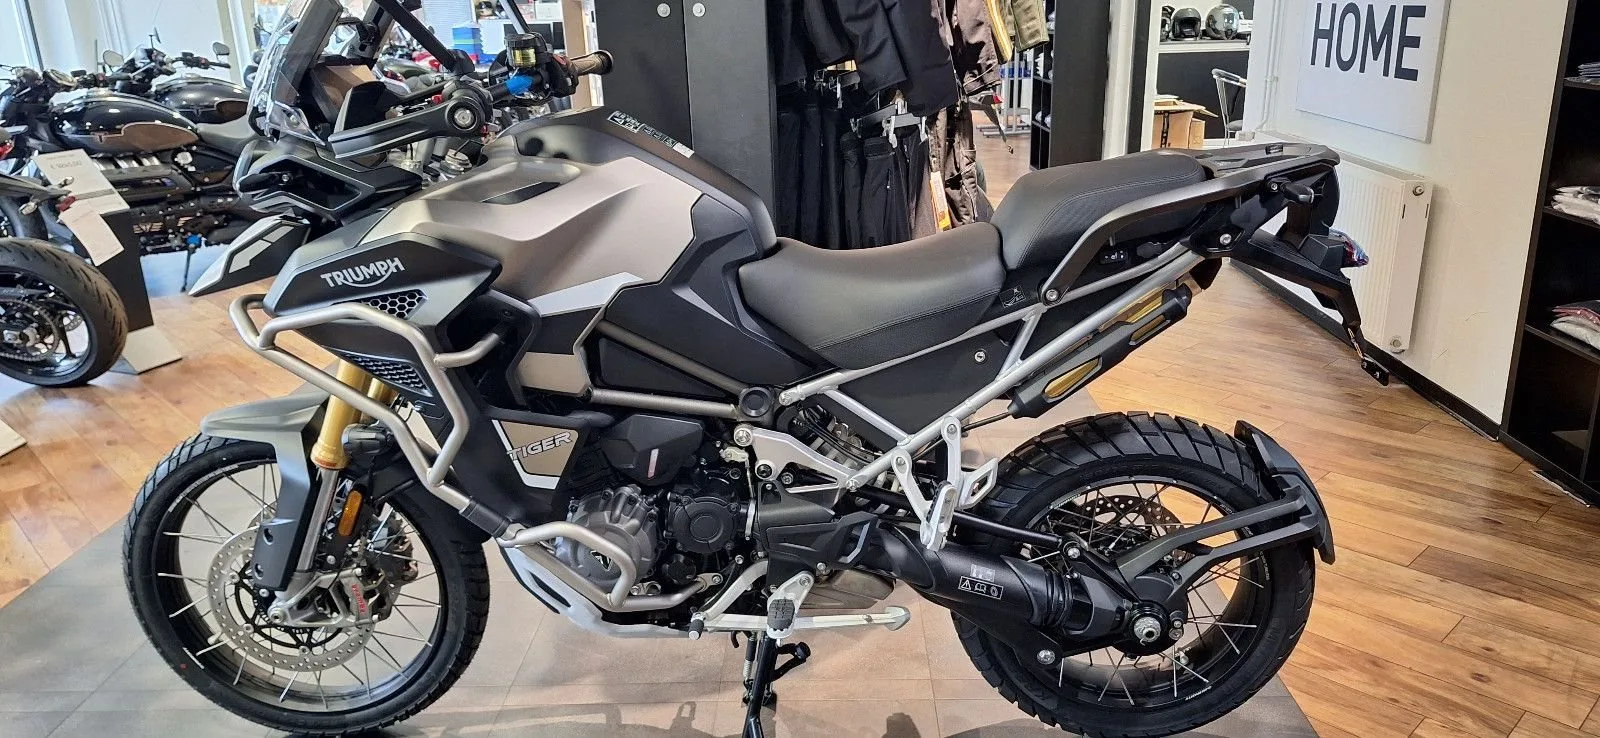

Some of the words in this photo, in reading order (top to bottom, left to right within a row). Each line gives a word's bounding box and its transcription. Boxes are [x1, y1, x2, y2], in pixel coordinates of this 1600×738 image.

[1310, 2, 1426, 82] HOME
[320, 257, 405, 288] TRIUMPH
[507, 431, 573, 461] TIGER
